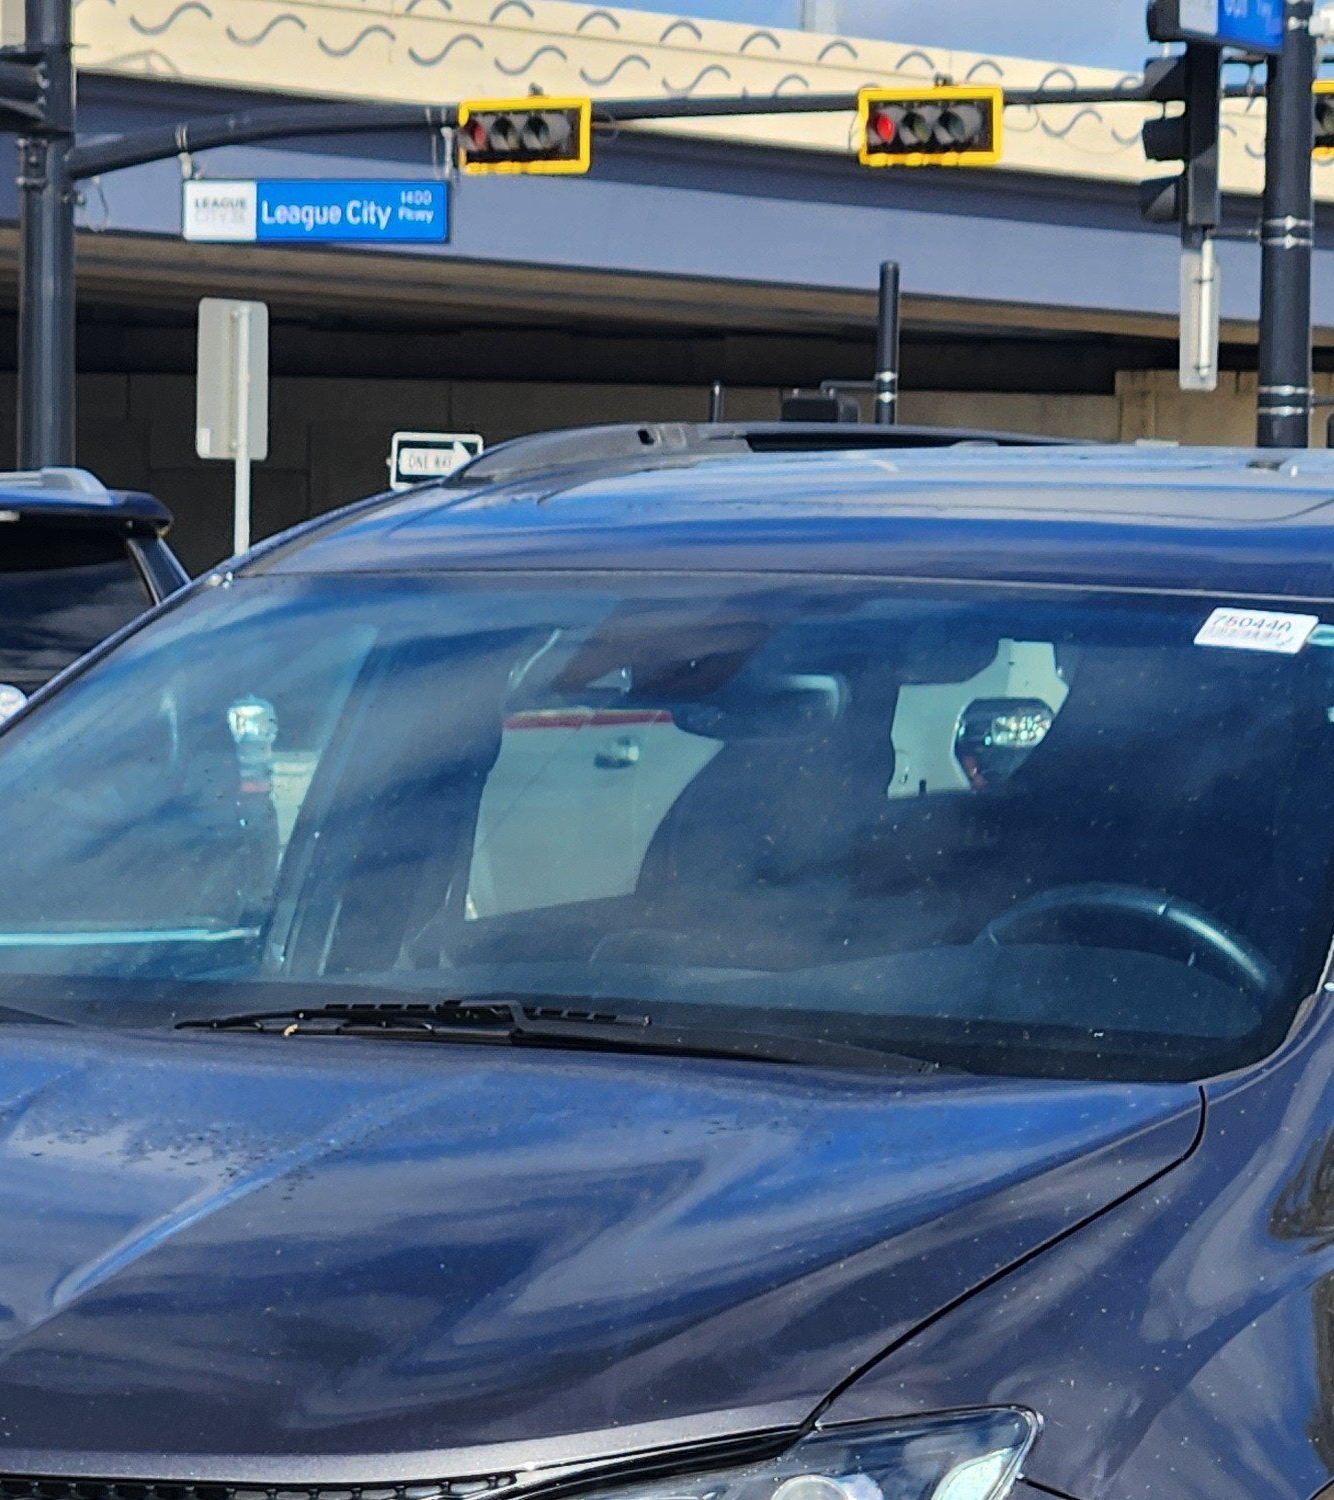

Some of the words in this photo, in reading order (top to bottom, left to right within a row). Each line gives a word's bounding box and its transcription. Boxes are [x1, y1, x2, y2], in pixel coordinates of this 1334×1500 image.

[194, 196, 247, 210] LEAGUE
[261, 200, 342, 232] League
[346, 199, 392, 230] City
[409, 455, 428, 469] ONE
